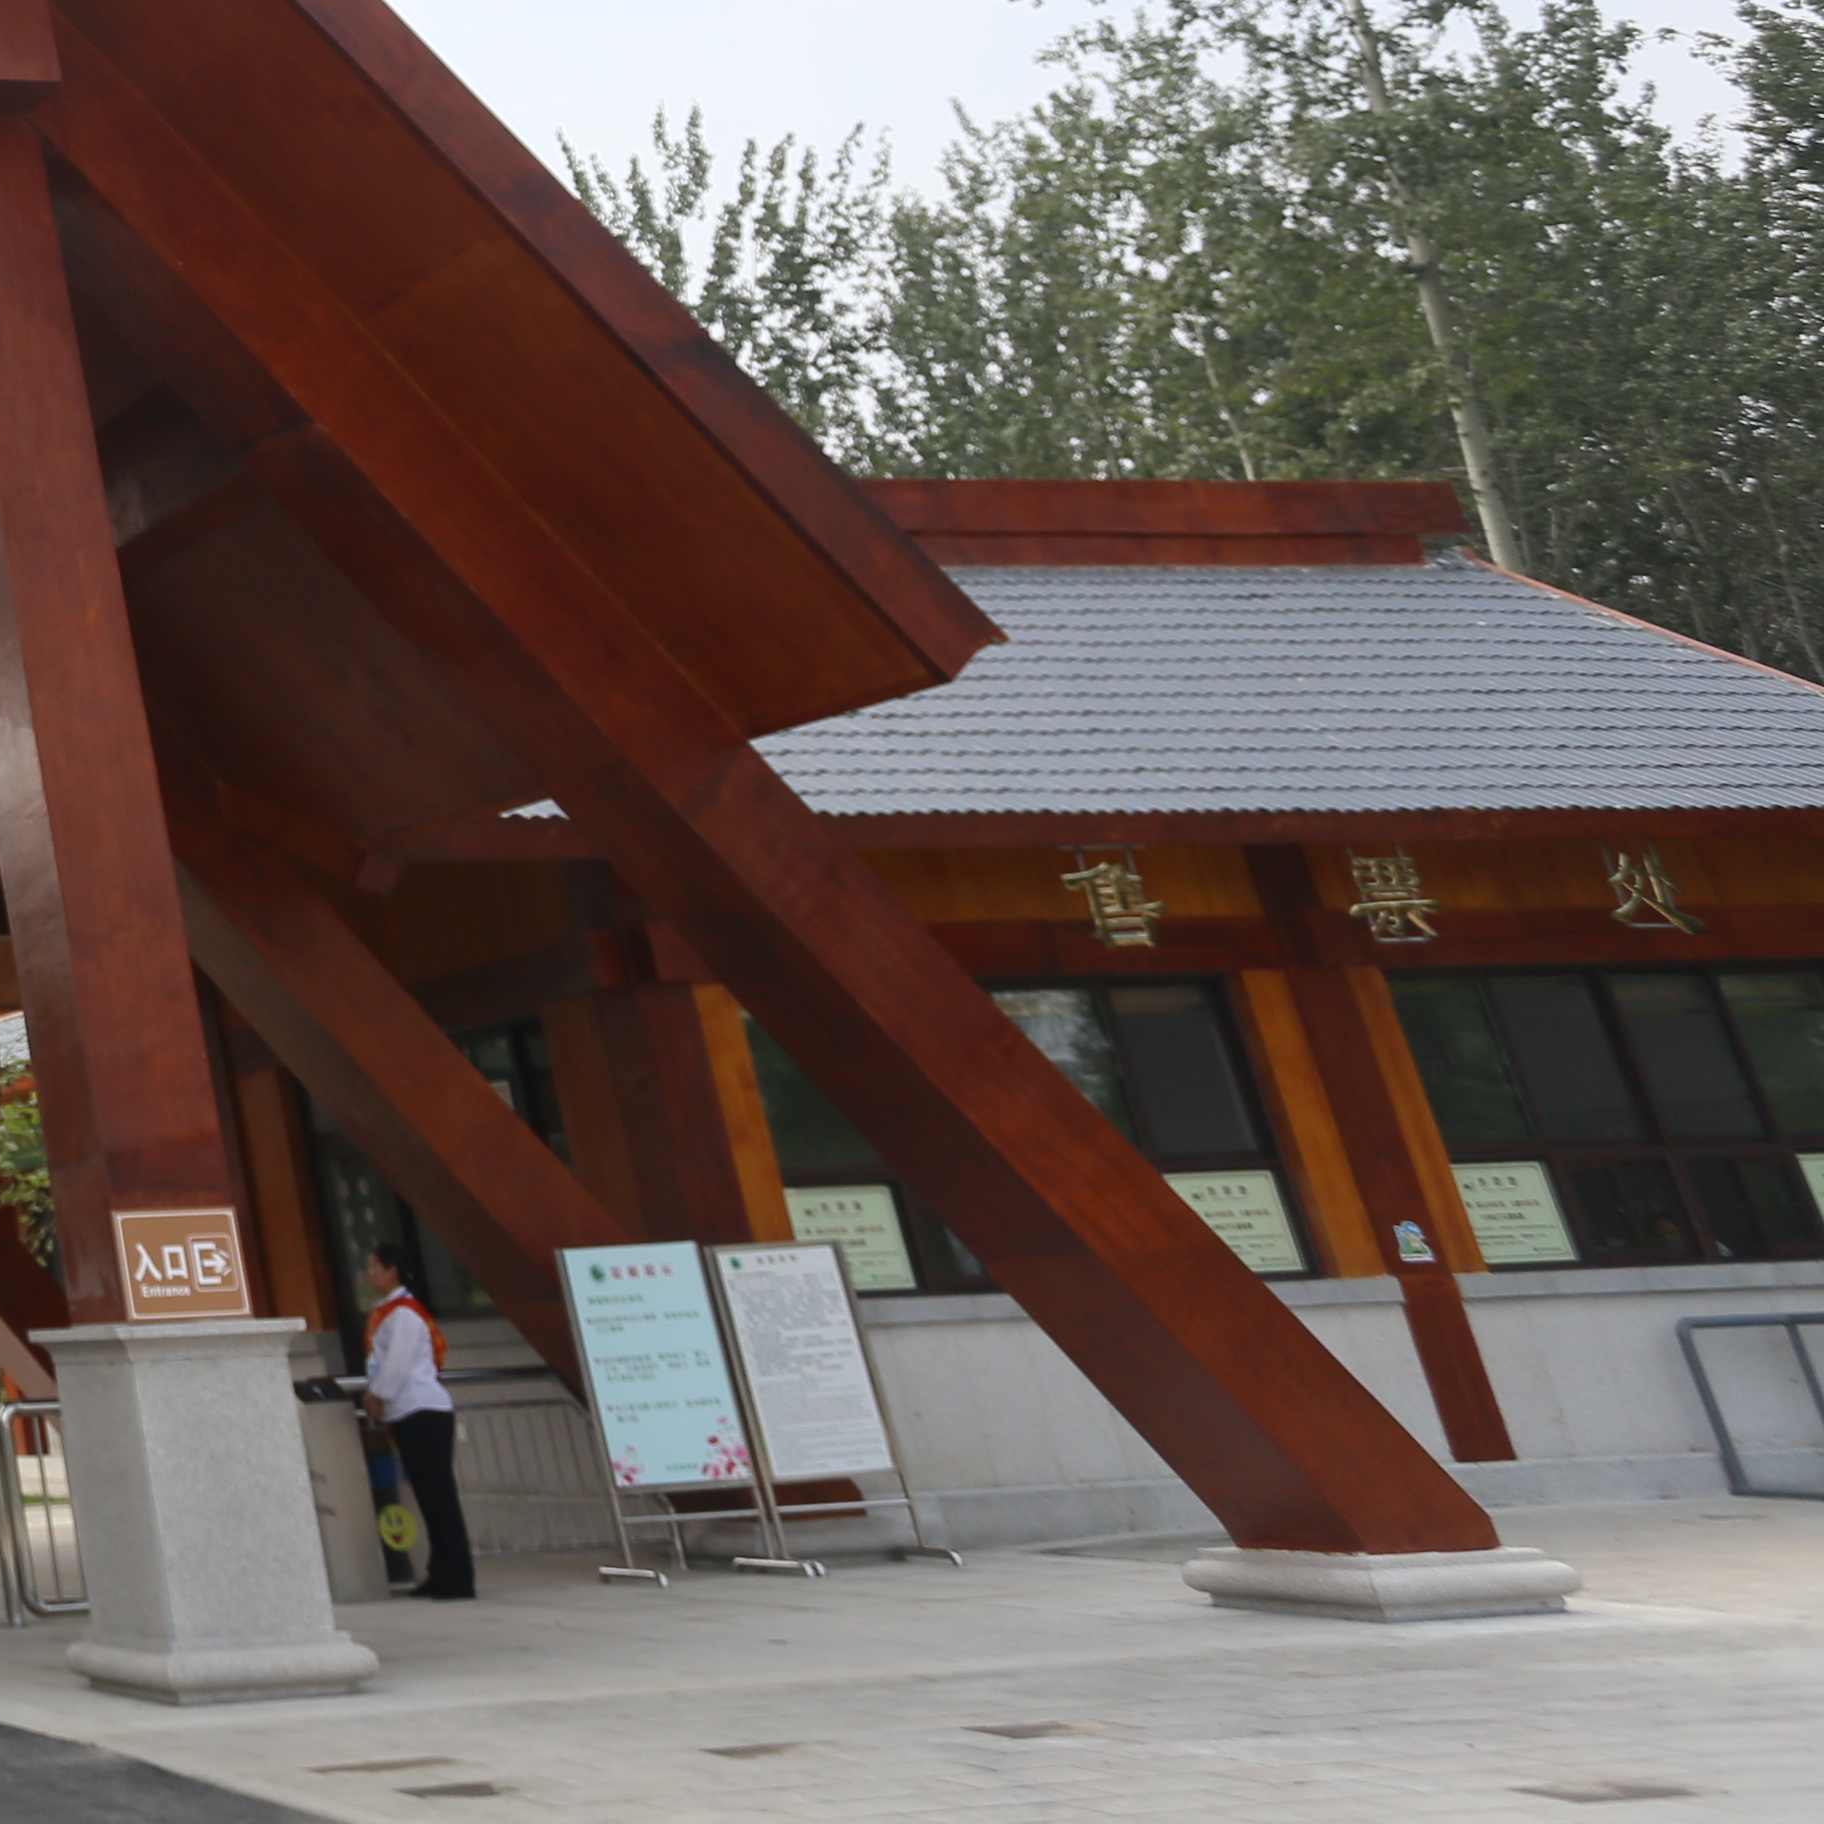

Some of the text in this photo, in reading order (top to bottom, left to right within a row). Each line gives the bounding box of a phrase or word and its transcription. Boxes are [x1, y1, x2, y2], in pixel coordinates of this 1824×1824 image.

[1060, 861, 1706, 948] 售票处
[135, 1243, 189, 1281] 入口
[142, 1285, 191, 1298] Entrance
